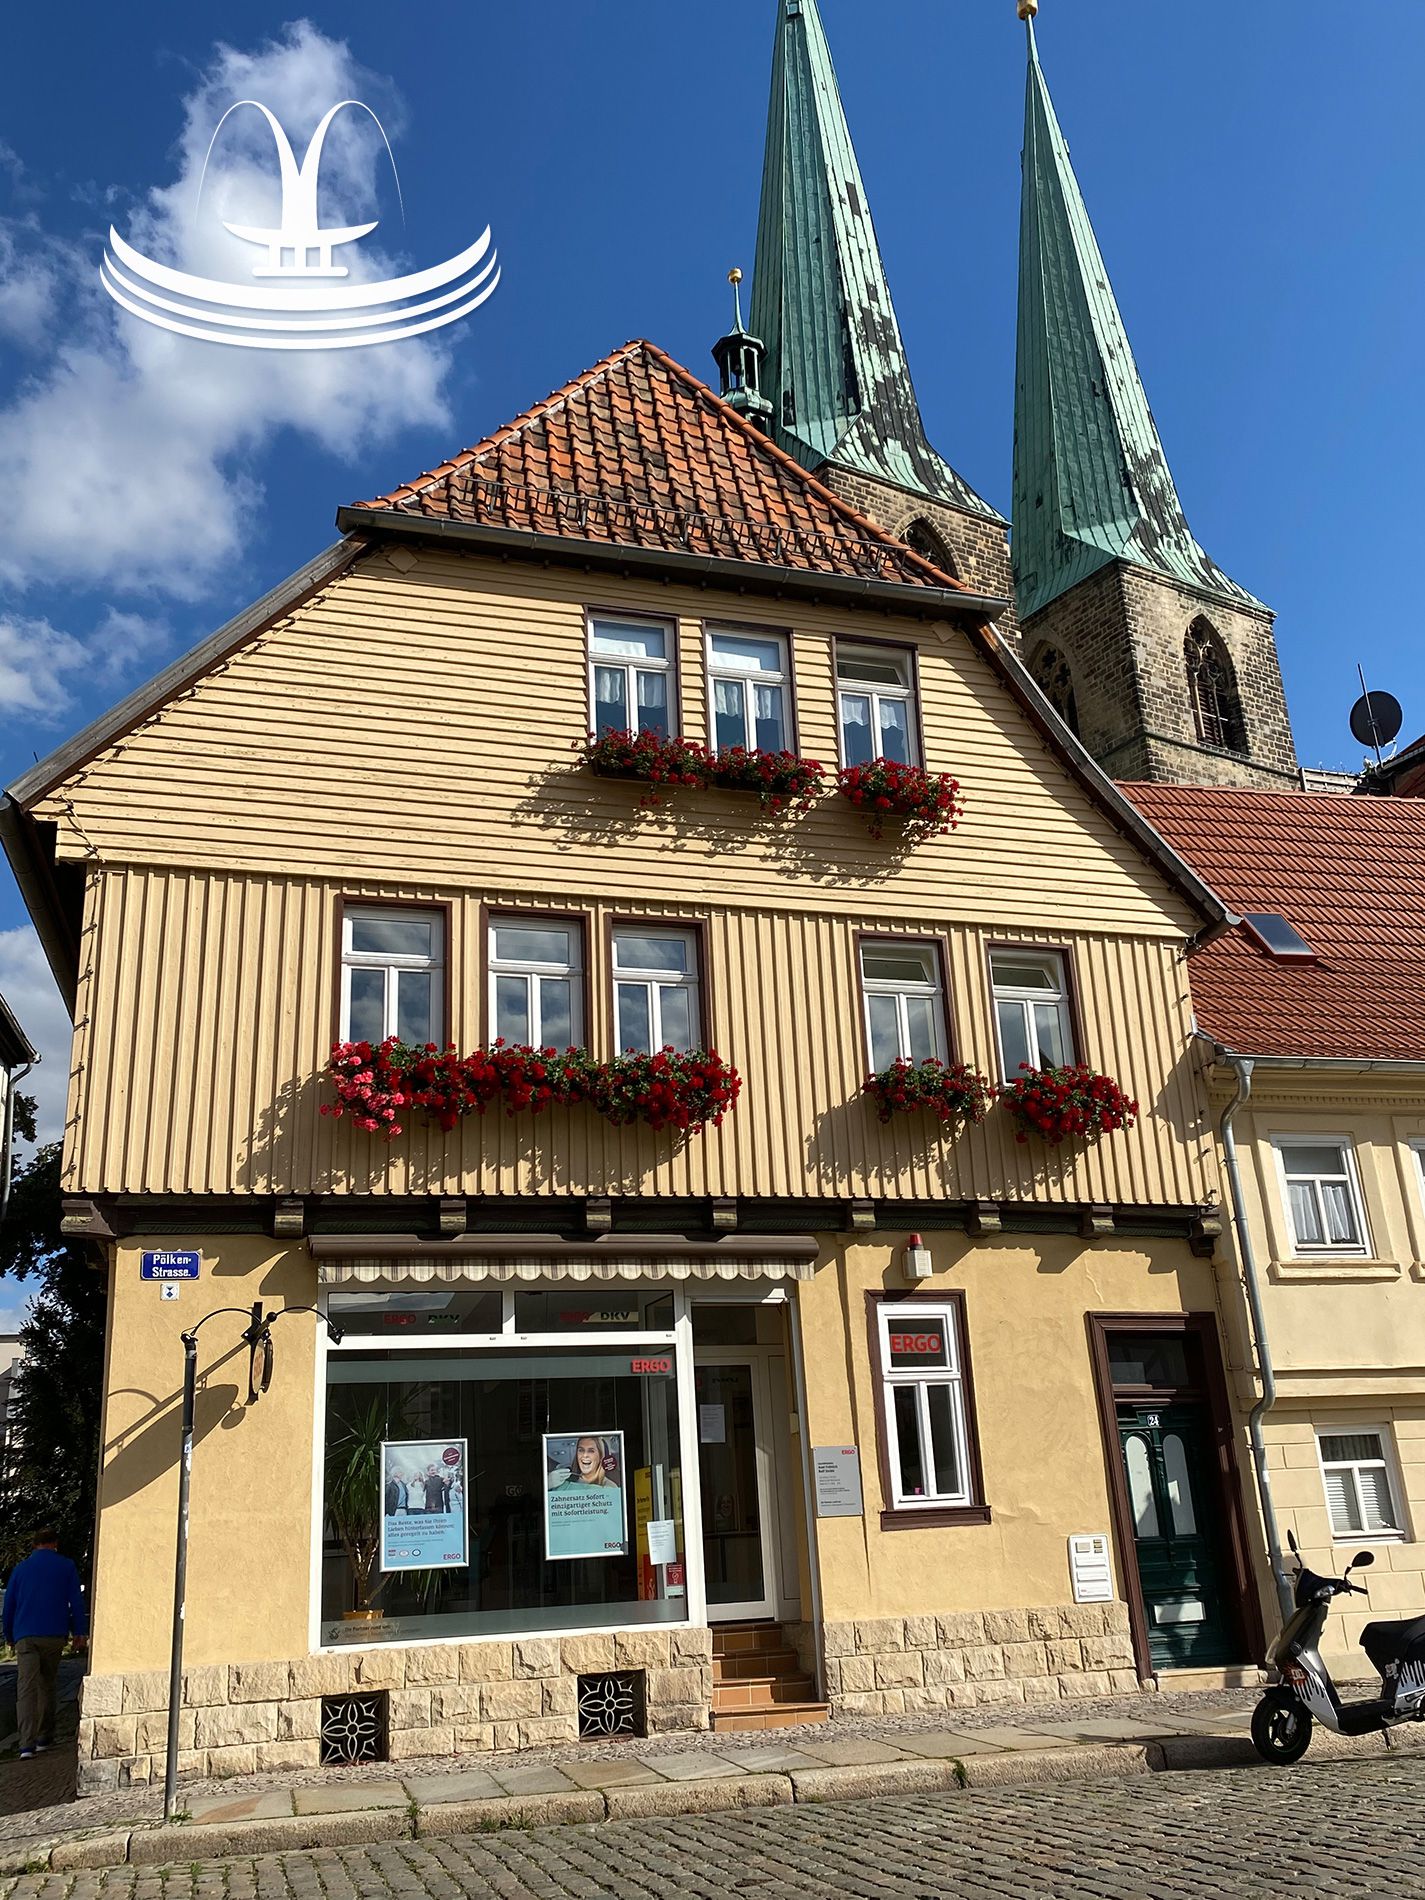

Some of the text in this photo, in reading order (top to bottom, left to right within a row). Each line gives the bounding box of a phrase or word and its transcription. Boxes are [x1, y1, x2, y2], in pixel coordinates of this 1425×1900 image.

[600, 1311, 630, 1320] DKV
[891, 1335, 942, 1352] ERGO
[632, 1358, 671, 1373] ERGO
[551, 1502, 591, 1510] einzigartiger
[564, 1508, 609, 1516] Sofortleistung.
